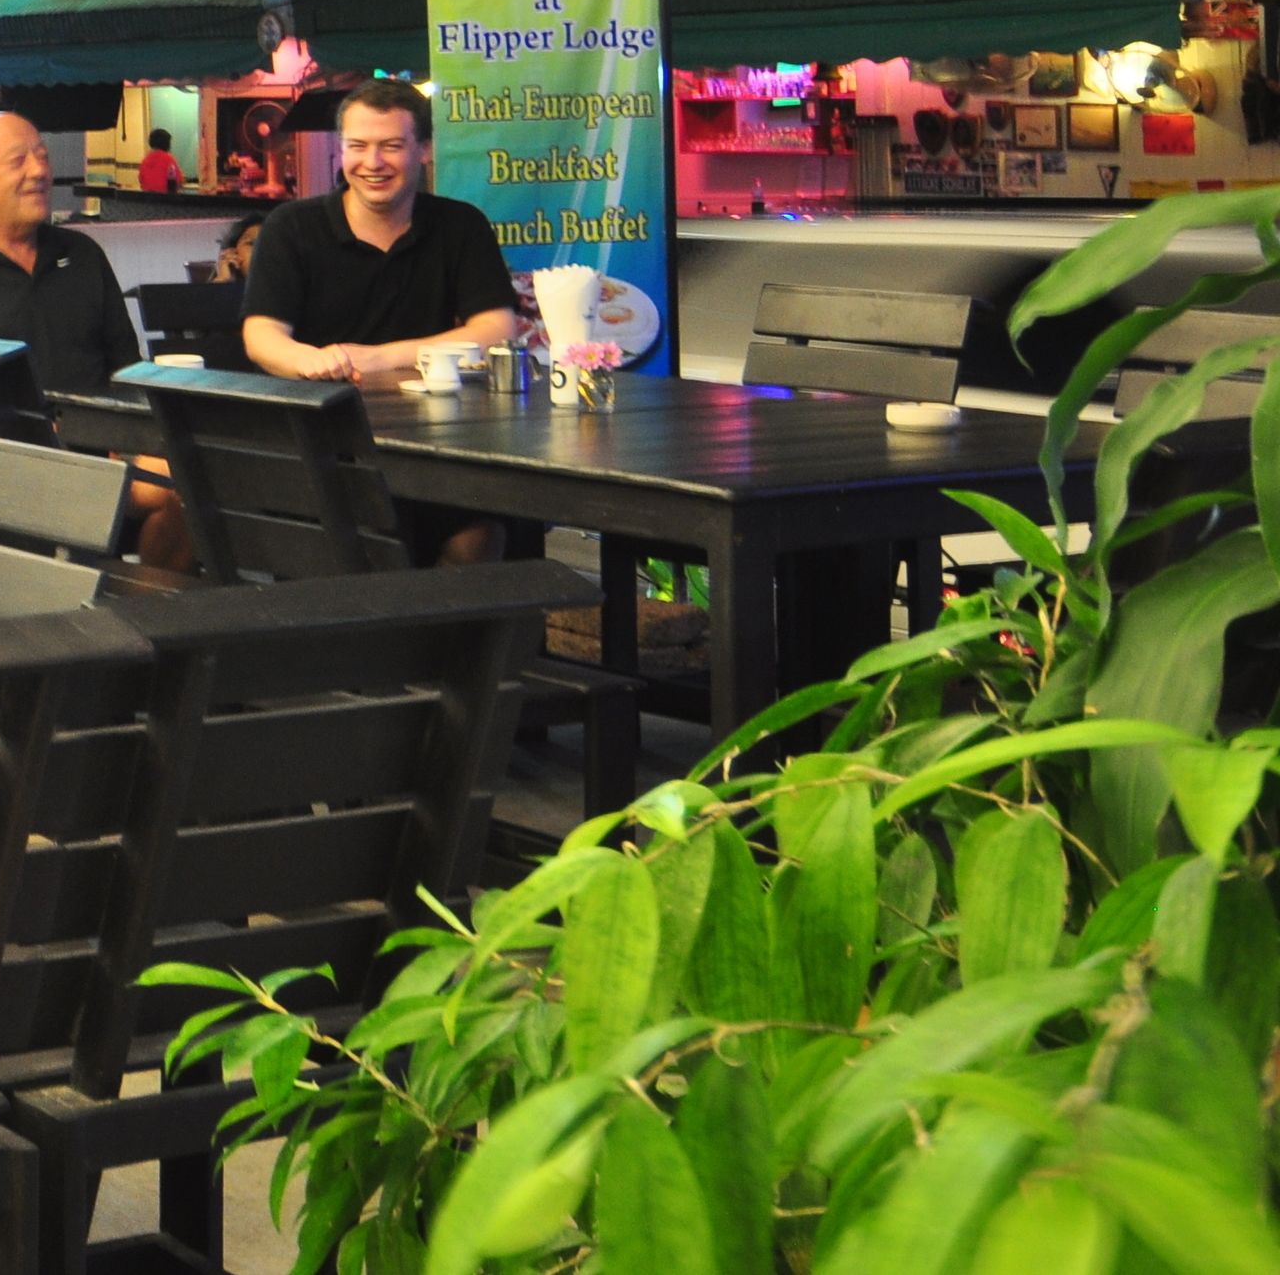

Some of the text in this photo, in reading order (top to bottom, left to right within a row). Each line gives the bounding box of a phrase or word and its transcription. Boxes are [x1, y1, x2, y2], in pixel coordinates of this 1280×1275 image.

[438, 20, 657, 60] Flipper Lodge
[443, 85, 655, 127] Thai-European
[489, 148, 620, 185] Breakfast
[491, 207, 648, 245] unch Buffet
[551, 360, 567, 389] 5
